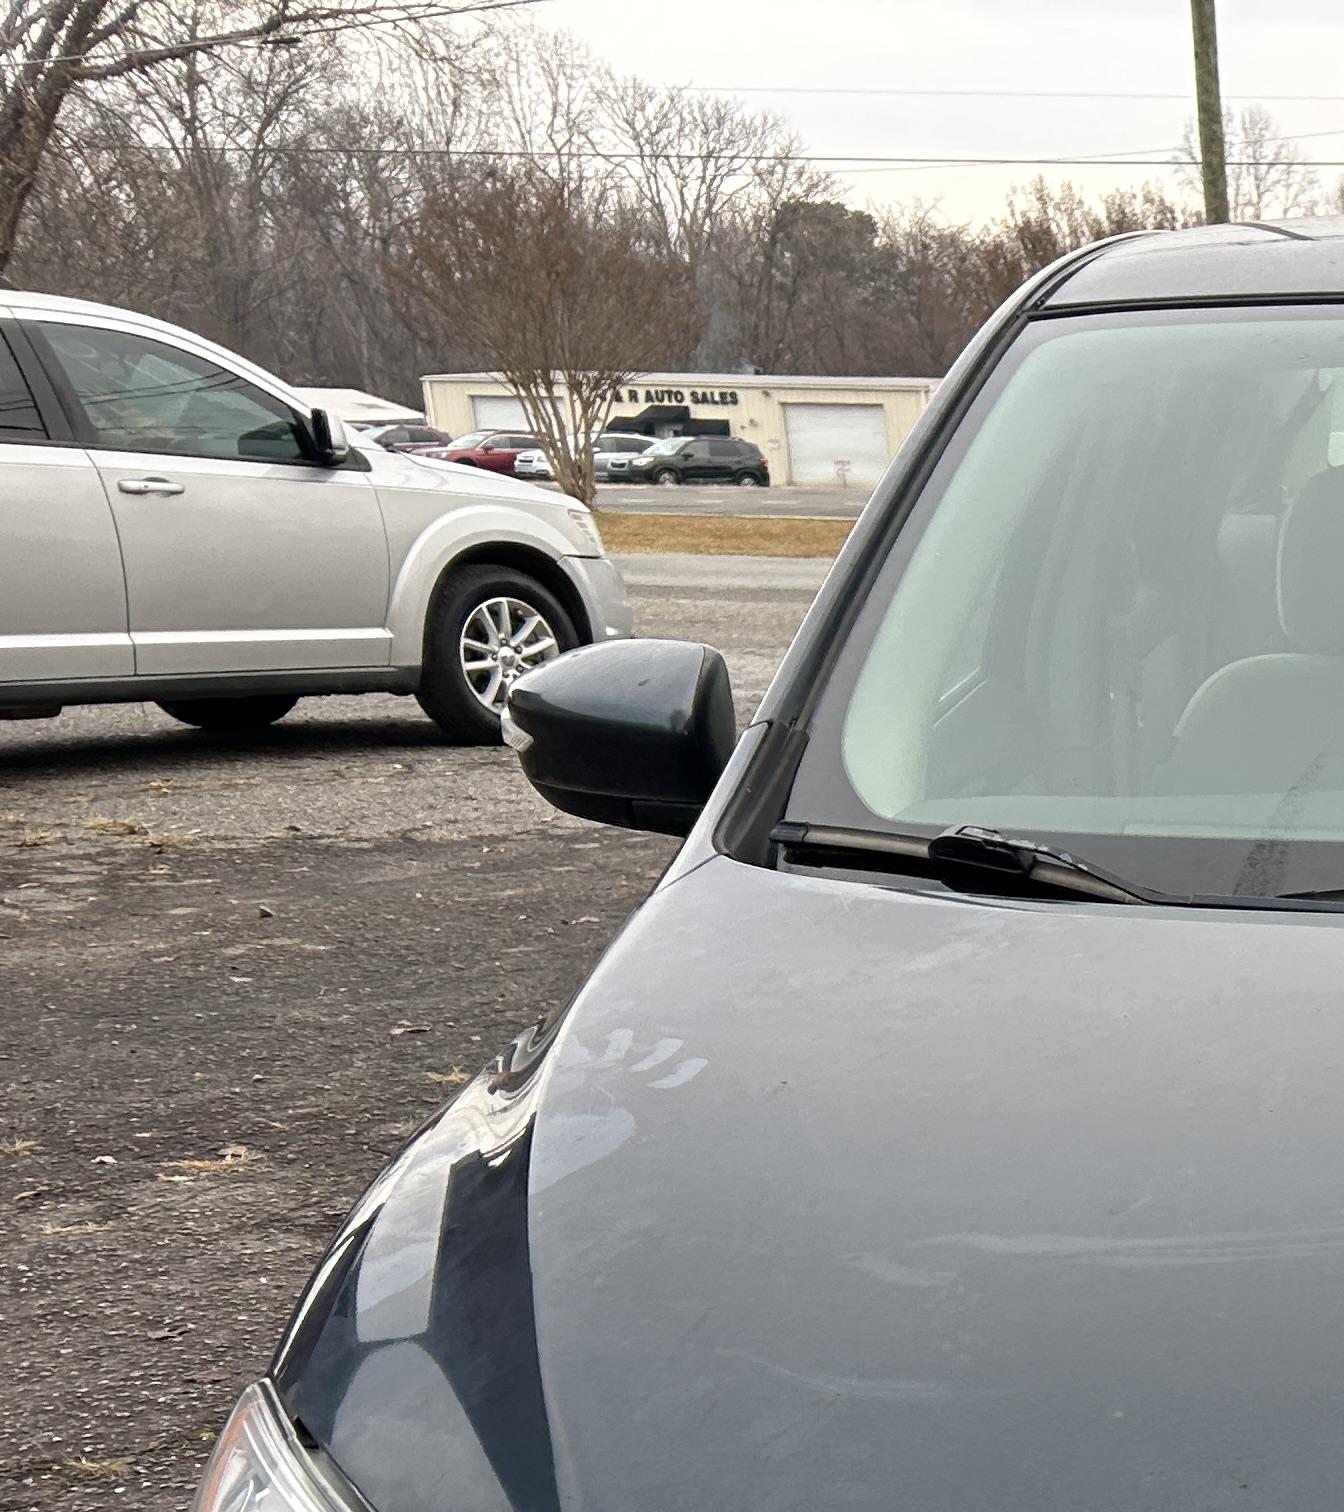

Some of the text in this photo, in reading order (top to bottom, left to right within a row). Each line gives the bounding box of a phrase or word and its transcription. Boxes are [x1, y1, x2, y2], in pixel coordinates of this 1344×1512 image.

[628, 389, 640, 403] R
[645, 389, 685, 404] AUTO
[690, 390, 738, 405] SALES
